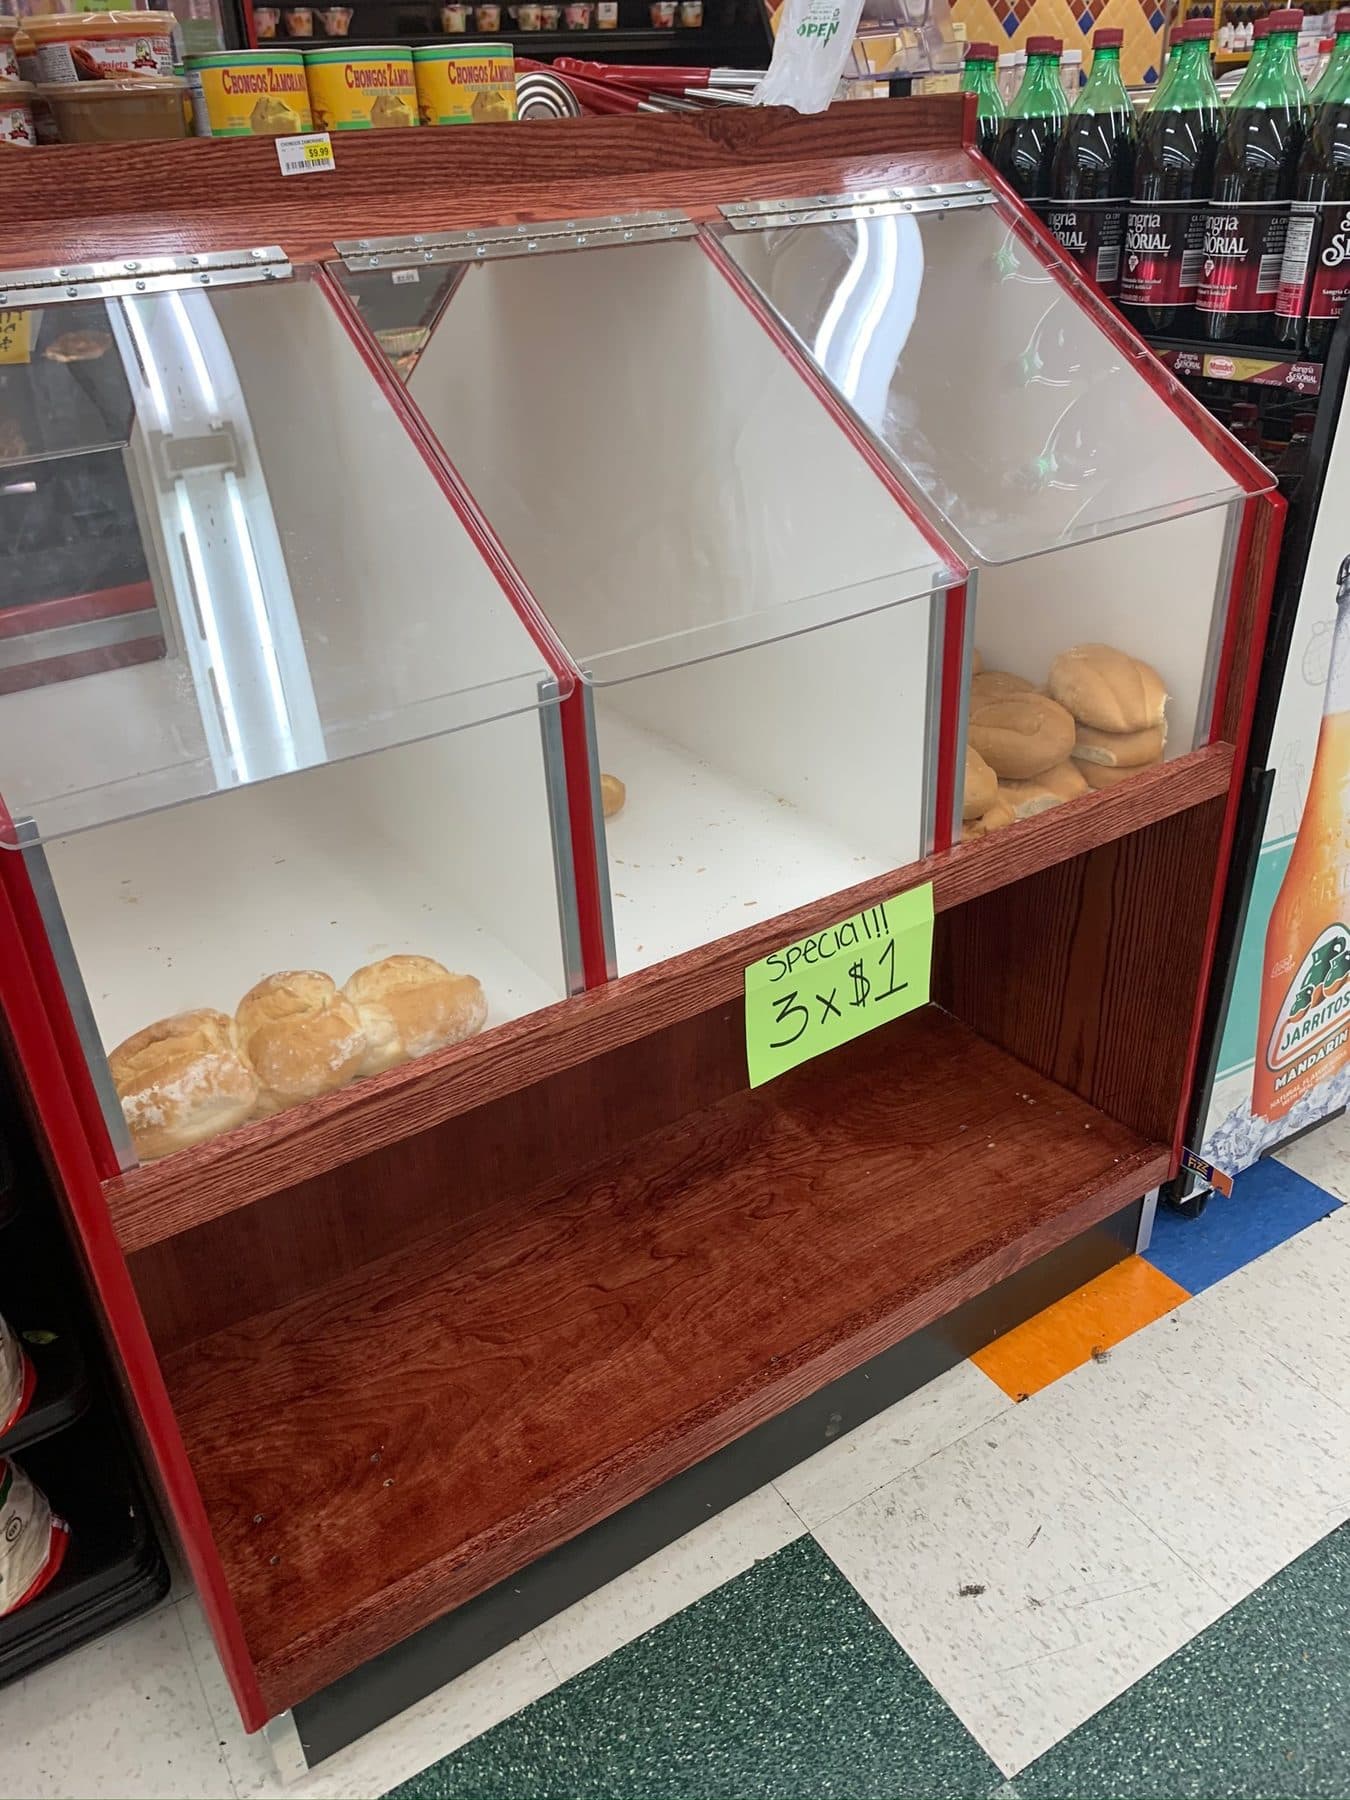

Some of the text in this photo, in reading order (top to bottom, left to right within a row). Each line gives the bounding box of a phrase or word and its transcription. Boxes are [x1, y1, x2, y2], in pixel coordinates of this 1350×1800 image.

[797, 21, 840, 44] OPEN
[222, 69, 267, 95] CHONGOS
[345, 64, 387, 88] CHONGOS
[448, 61, 488, 84] CHONGOS
[309, 146, 329, 158] $9.99
[1280, 990, 1350, 1051] JARRITOS
[1274, 1028, 1349, 1092] MANDARIN
